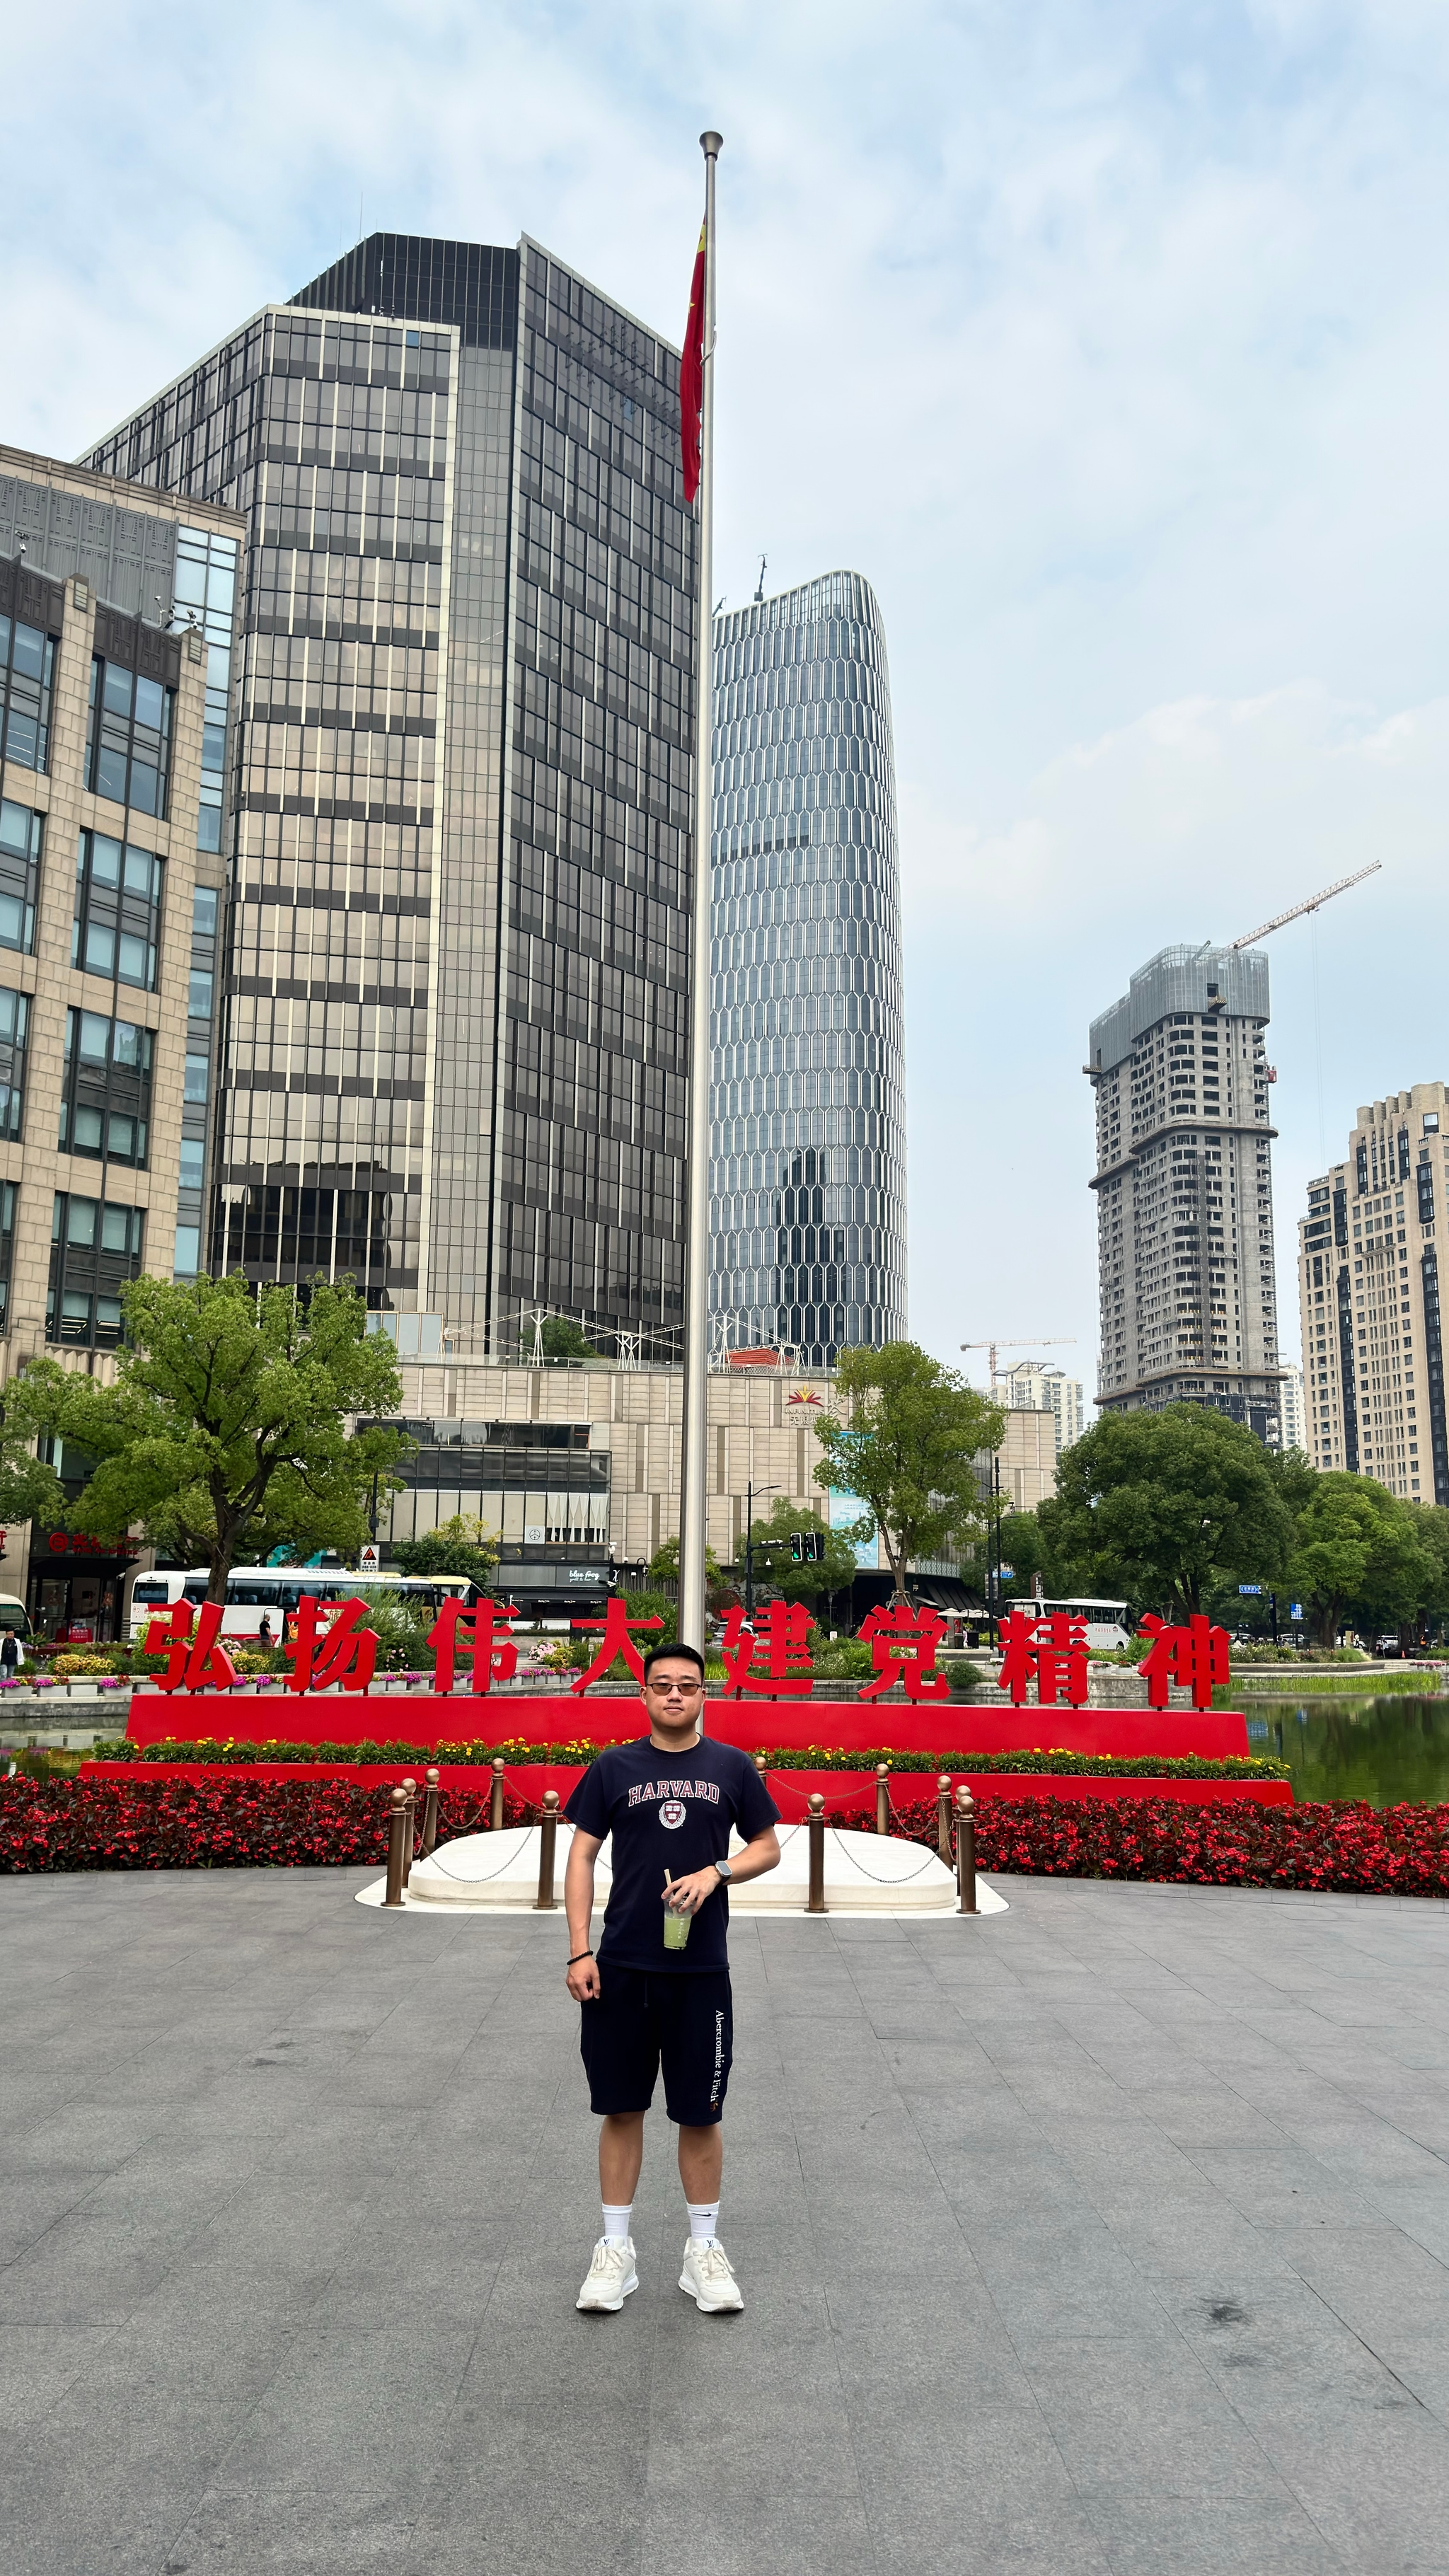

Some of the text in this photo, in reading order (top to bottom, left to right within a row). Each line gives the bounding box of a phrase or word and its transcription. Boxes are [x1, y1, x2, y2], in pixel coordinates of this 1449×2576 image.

[569, 1569, 601, 1581] blue frog
[144, 1595, 1232, 1709] 弘扬伟大建党精神
[628, 1780, 720, 1807] HARVARD
[715, 2010, 725, 2069] Abercrombie
[710, 2079, 721, 2102] Fitch
